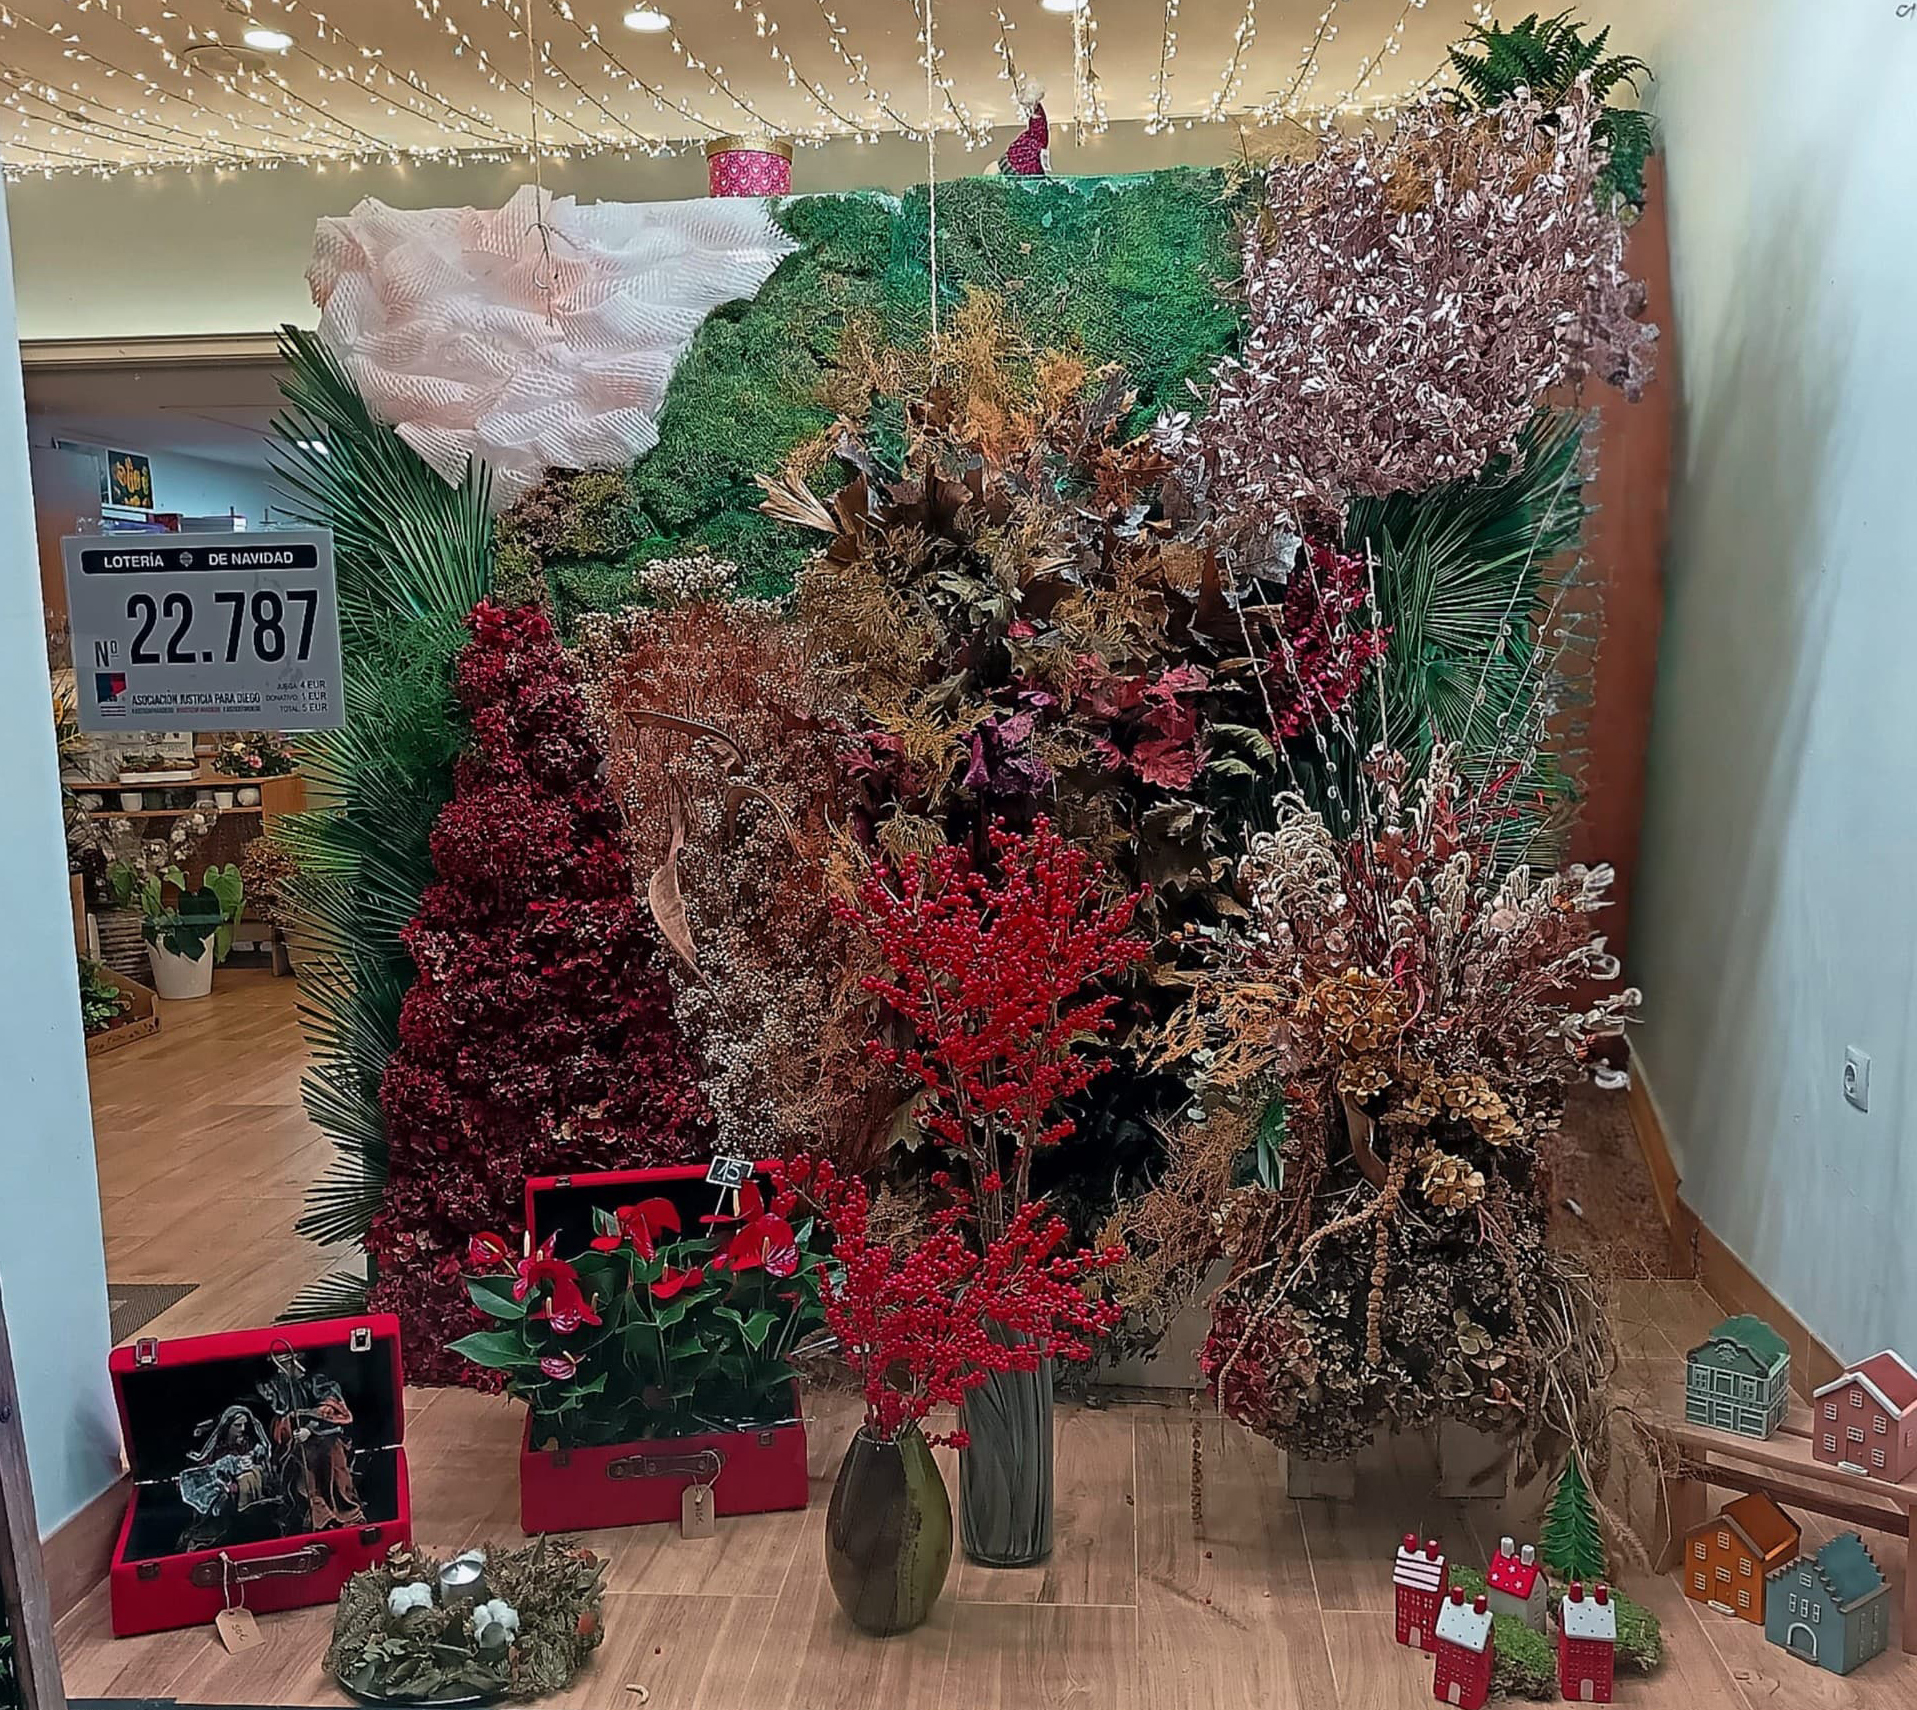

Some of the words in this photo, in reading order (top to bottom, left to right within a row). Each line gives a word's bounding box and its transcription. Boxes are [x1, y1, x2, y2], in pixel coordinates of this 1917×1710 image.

[104, 552, 164, 568] LOTERÍA
[208, 553, 228, 566] DE
[231, 551, 294, 565] NAVIDAD
[127, 589, 318, 664] 22.787
[307, 680, 326, 689] EUR
[132, 689, 178, 705] ASOCIACIÓN
[179, 694, 213, 705] JUSTICIA
[214, 693, 236, 704] PARA
[236, 692, 261, 703] DIEGO
[308, 691, 327, 700] EUR
[301, 703, 307, 712] 5
[309, 702, 328, 711] EUR
[717, 1159, 741, 1182] 15
